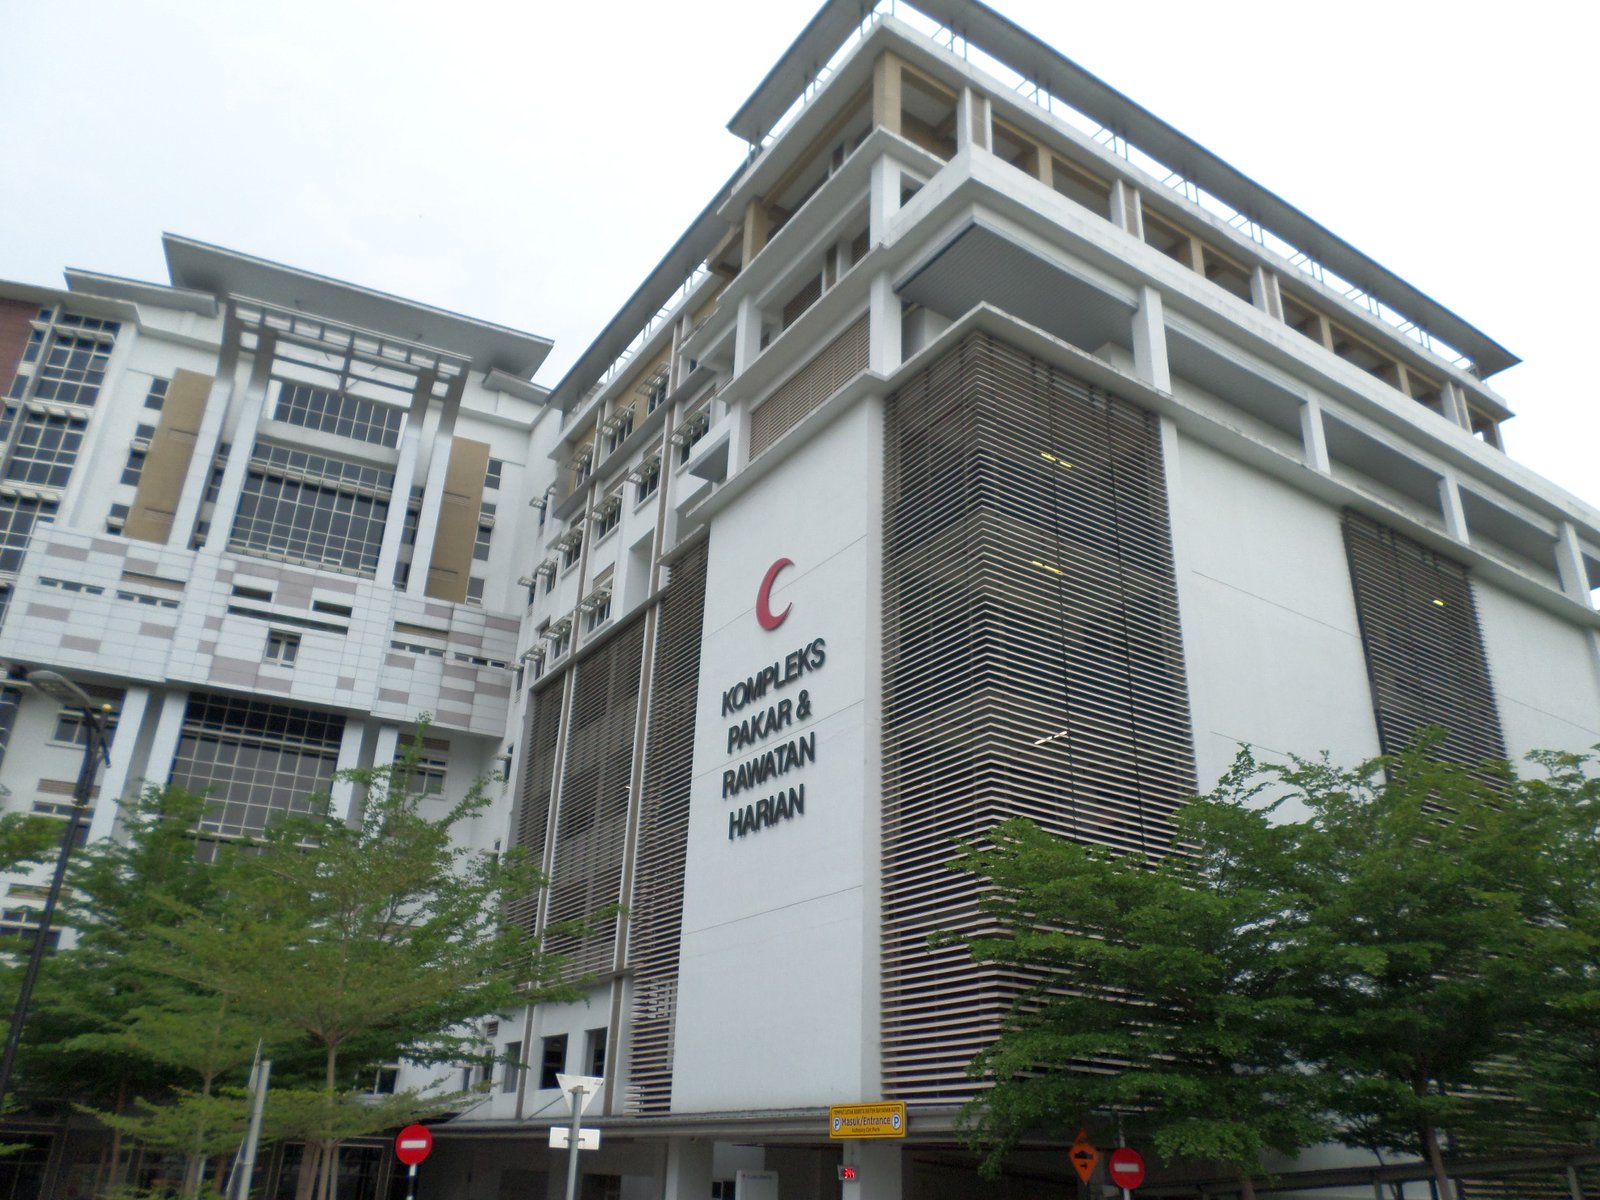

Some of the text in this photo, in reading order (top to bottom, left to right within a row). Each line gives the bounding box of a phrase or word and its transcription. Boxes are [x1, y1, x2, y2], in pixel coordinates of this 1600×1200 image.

[721, 638, 825, 717] KOMPLEKS
[727, 689, 812, 754] PAKAR &
[722, 731, 815, 799] RAWATAN
[728, 783, 804, 840] HARIAN
[841, 1116, 891, 1126] Masuk/Entrance
